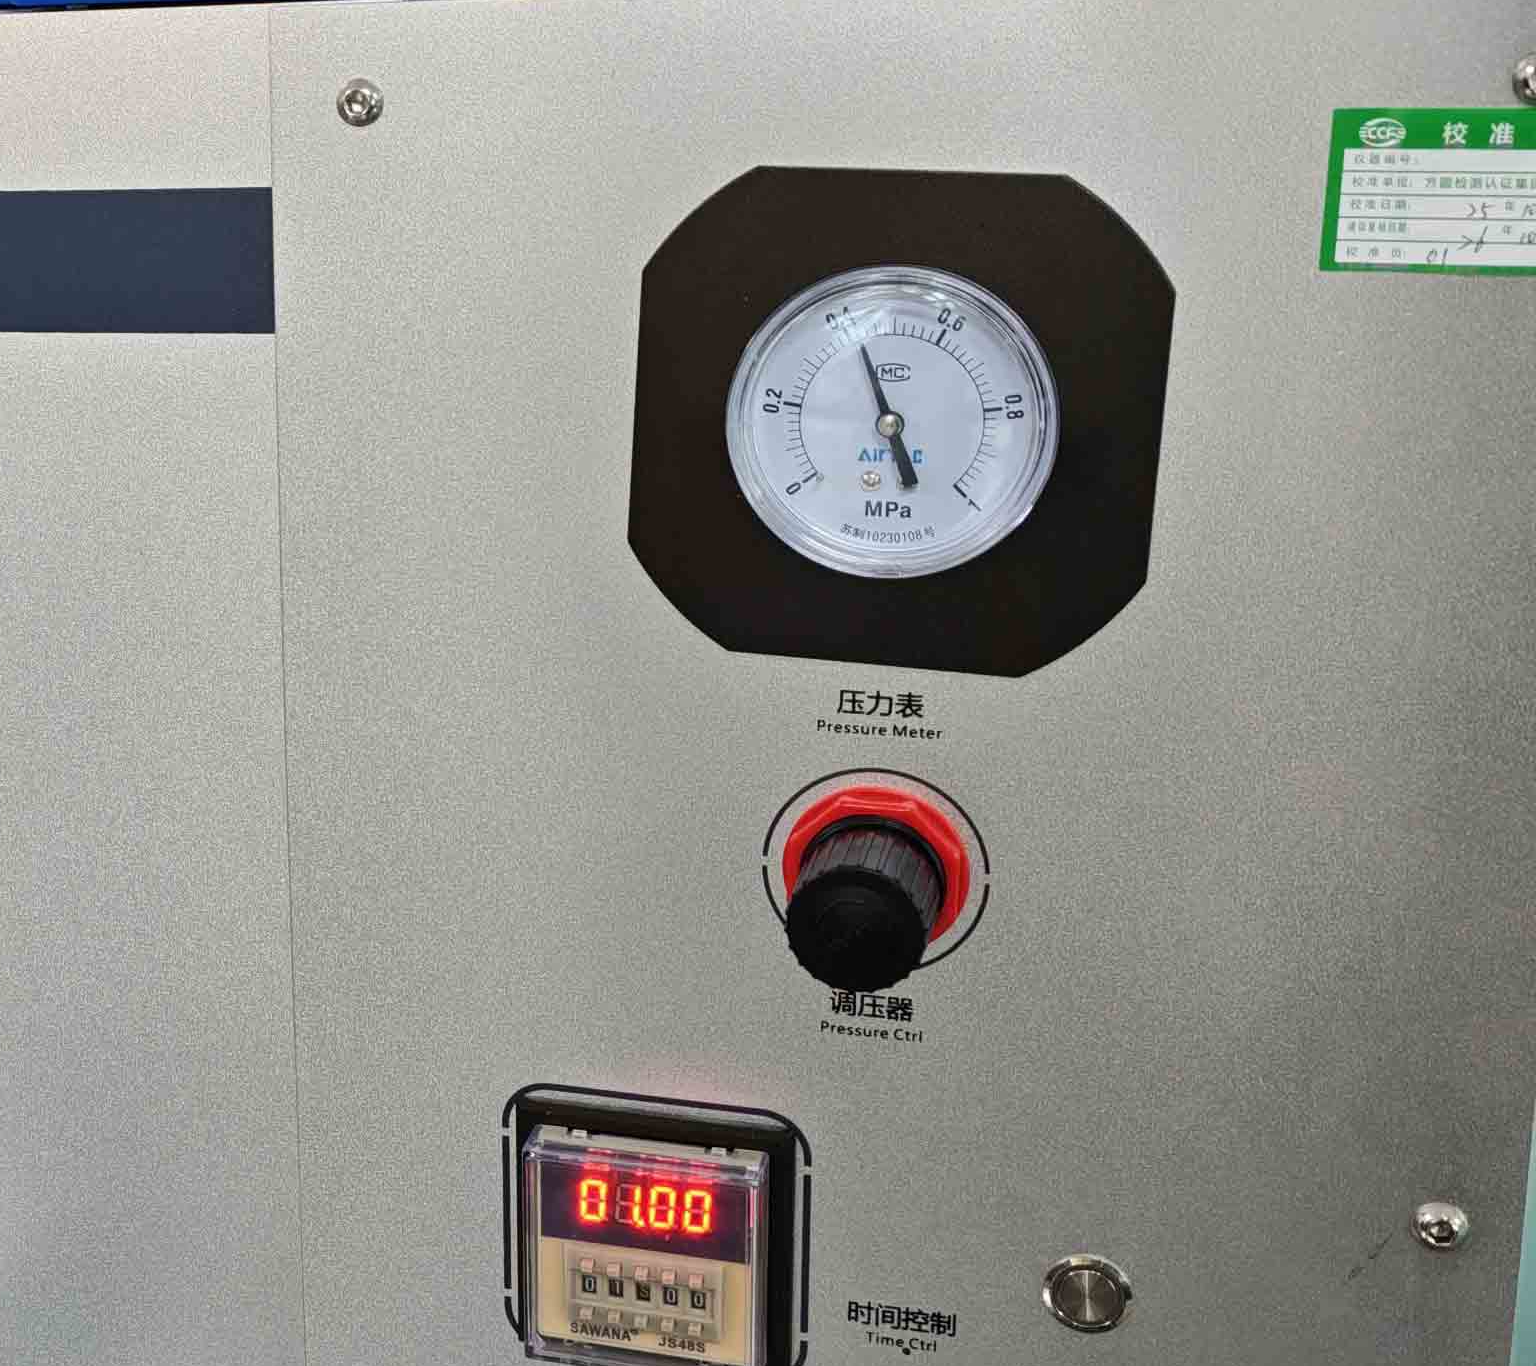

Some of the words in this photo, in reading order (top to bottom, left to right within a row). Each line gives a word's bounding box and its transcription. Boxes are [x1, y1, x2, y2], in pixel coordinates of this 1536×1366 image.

[936, 306, 968, 332] 0.6
[762, 387, 784, 415] 0.2
[1003, 393, 1026, 421] 0.8
[784, 480, 803, 497] 0
[864, 499, 913, 520] MPa
[837, 690, 925, 719] 压力表
[816, 719, 889, 738] Pressure
[892, 725, 944, 741] Meter
[830, 990, 914, 1023] 调压器
[820, 1020, 890, 1041] Pressure
[893, 1028, 924, 1044] Ctrl
[847, 1300, 957, 1337] 时间控制
[866, 1331, 905, 1349] Time
[909, 1337, 938, 1353] Ctrl
